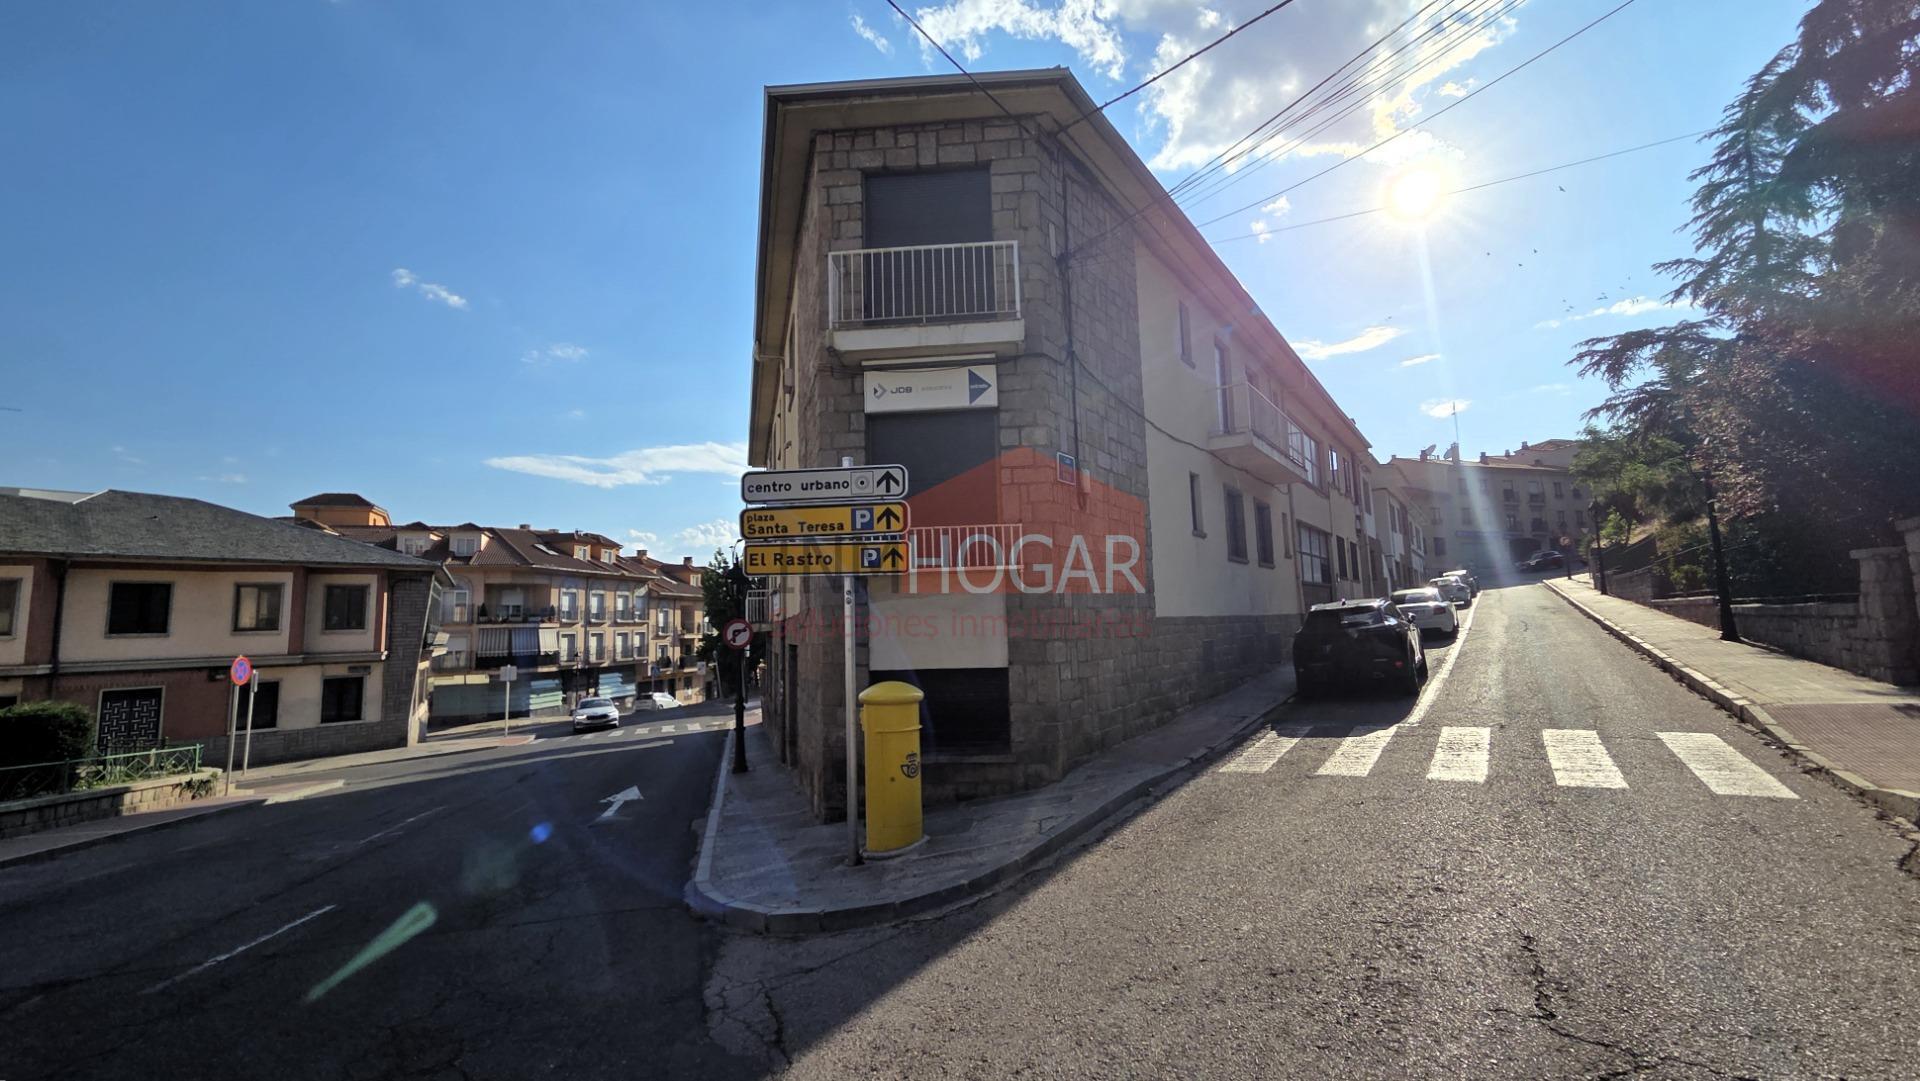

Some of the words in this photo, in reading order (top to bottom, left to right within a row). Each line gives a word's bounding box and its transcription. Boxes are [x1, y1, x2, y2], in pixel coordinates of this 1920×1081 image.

[747, 480, 792, 493] centro
[801, 478, 850, 491] urbano
[746, 513, 775, 523] plaza
[747, 523, 788, 535] Santa
[798, 521, 844, 532] Teresa
[855, 510, 871, 529] P
[750, 553, 765, 567] El
[773, 552, 833, 566] Rastro
[863, 550, 878, 567] P
